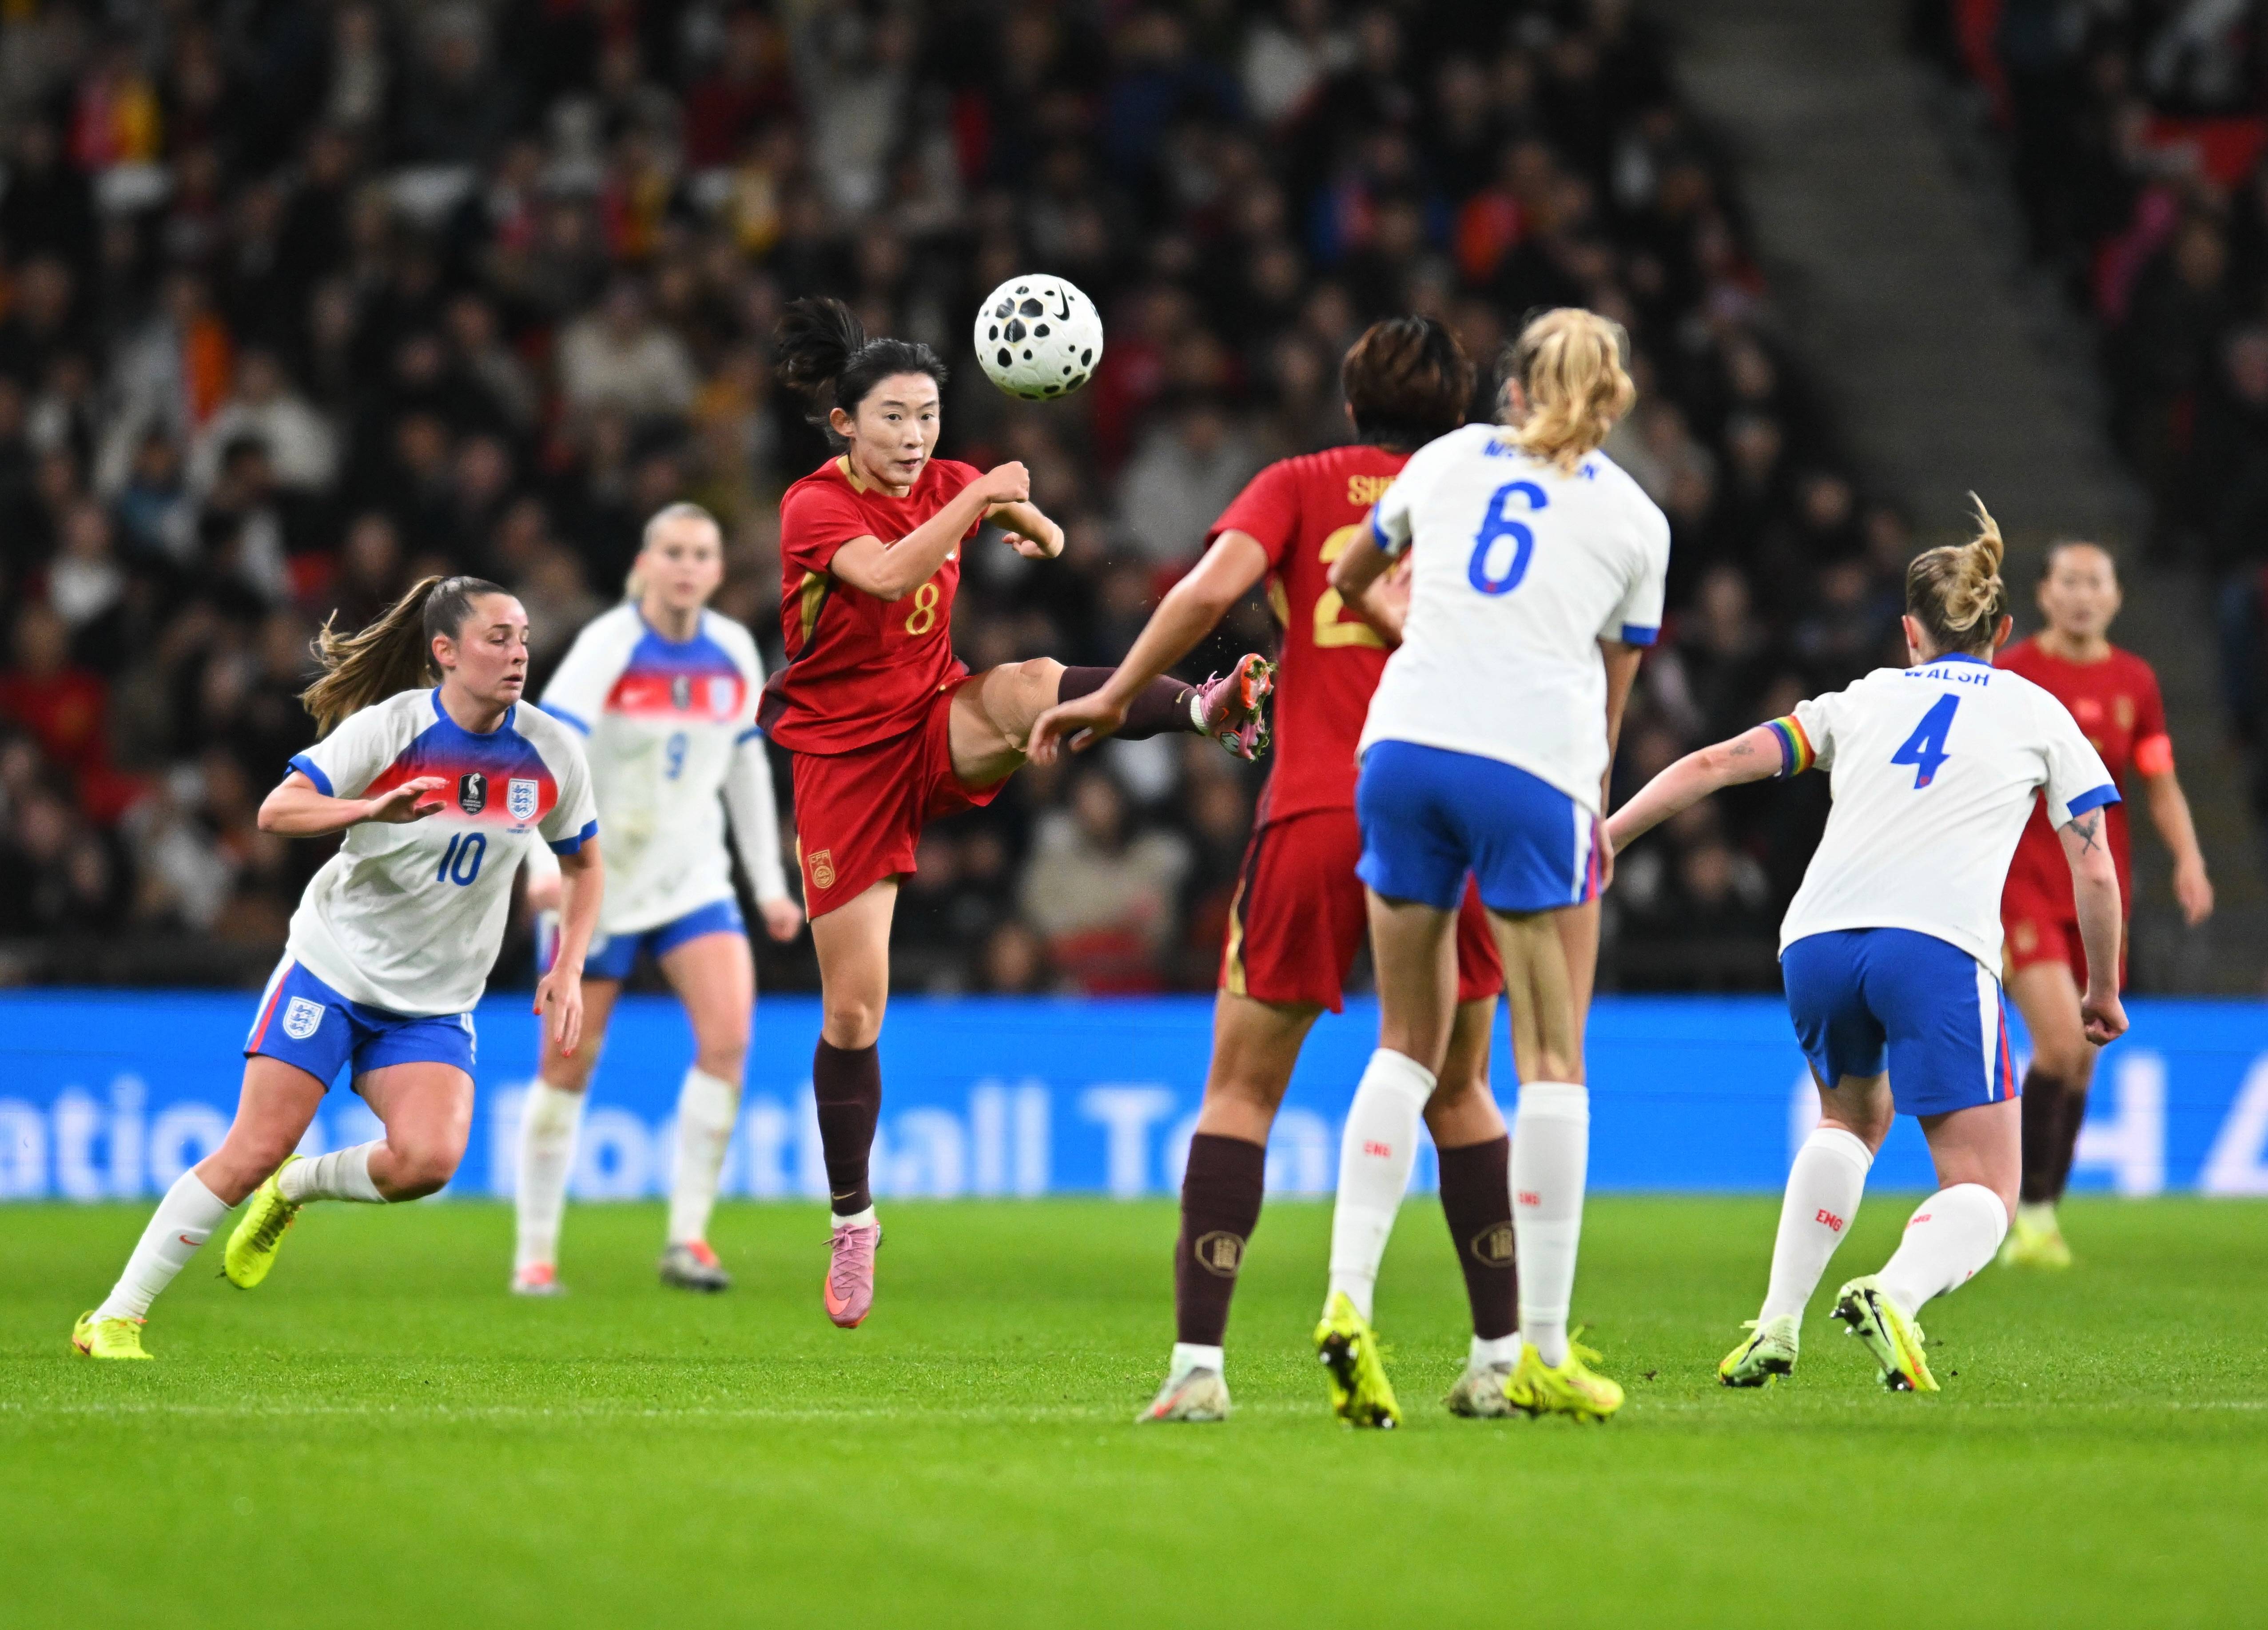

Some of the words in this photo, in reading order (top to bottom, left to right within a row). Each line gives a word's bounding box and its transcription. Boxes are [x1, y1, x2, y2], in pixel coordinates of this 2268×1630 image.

[1347, 475, 1396, 506] SH
[1468, 480, 1549, 596] 6
[905, 583, 939, 636] 8
[664, 731, 688, 781] 9
[1890, 692, 1961, 789] 4
[437, 831, 486, 886] 10
[1816, 1209, 1843, 1232] ENG
